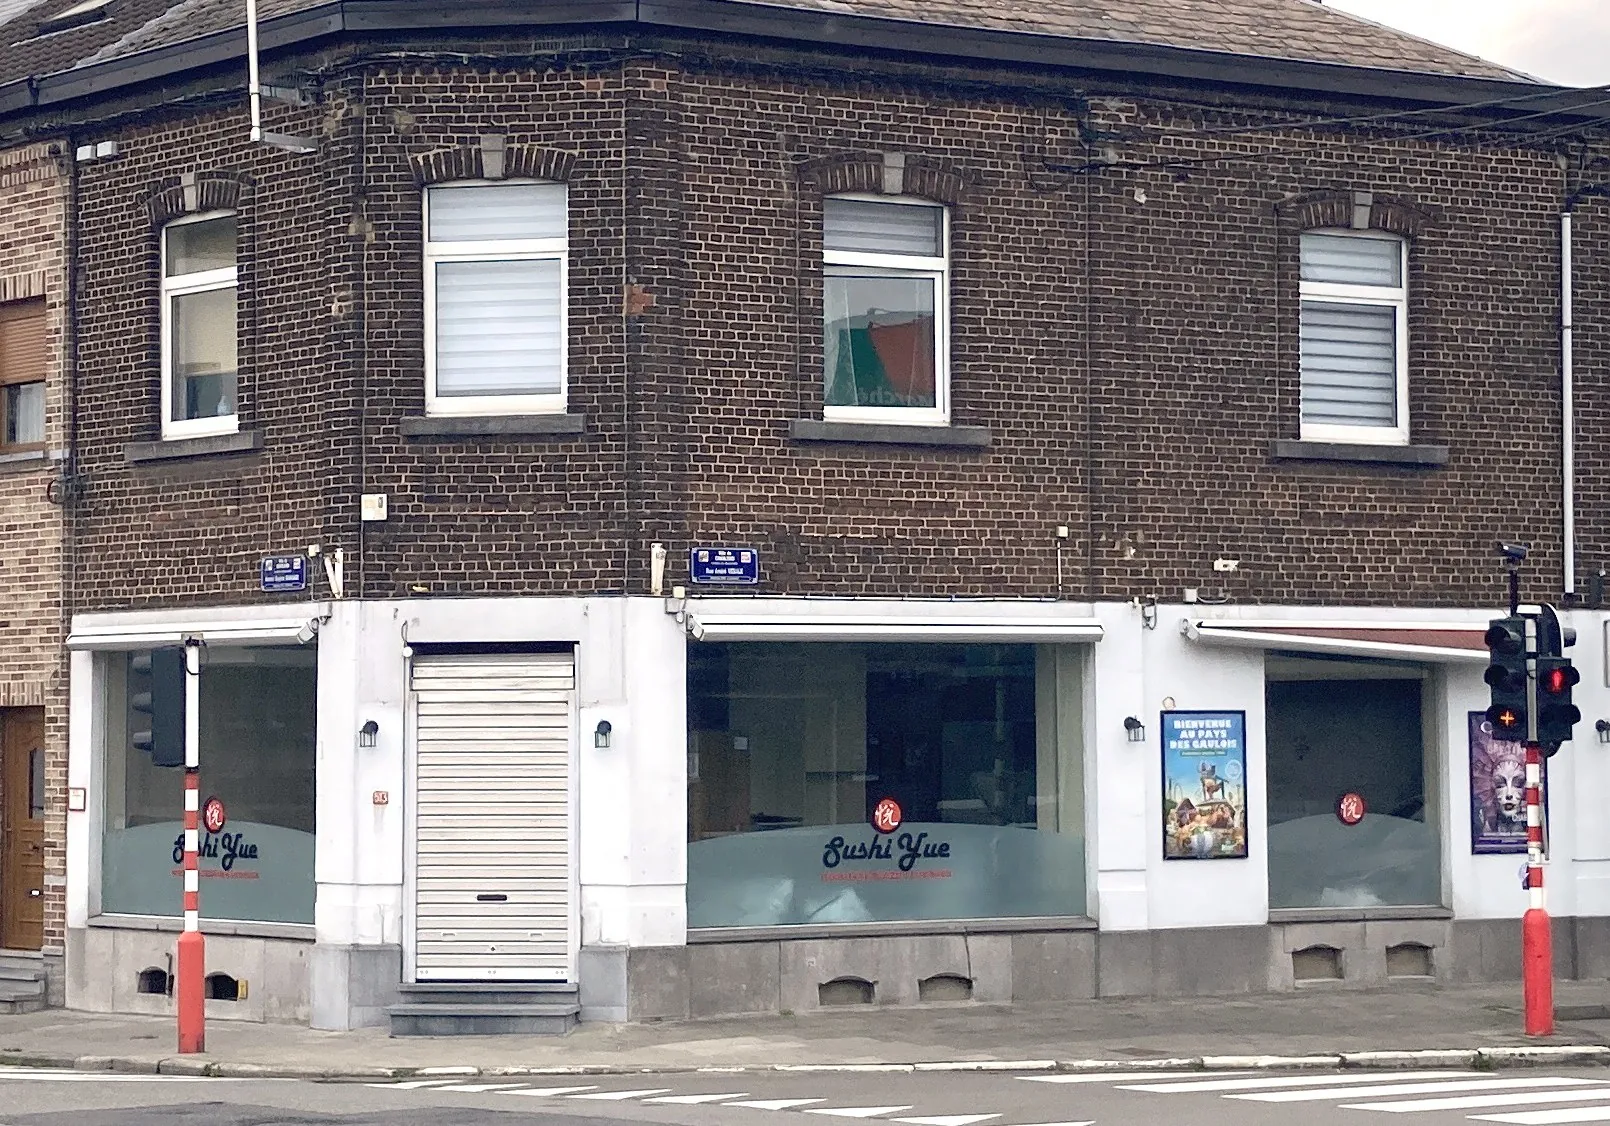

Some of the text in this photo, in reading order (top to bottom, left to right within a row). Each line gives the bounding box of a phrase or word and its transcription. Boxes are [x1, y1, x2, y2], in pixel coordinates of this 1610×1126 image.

[1173, 719, 1232, 730] BIENVENUE
[1180, 729, 1227, 739] AU PAYS
[1169, 739, 1238, 749] DES GAULOIS
[221, 832, 258, 871] Yue
[822, 832, 950, 872] Sushi Yue
